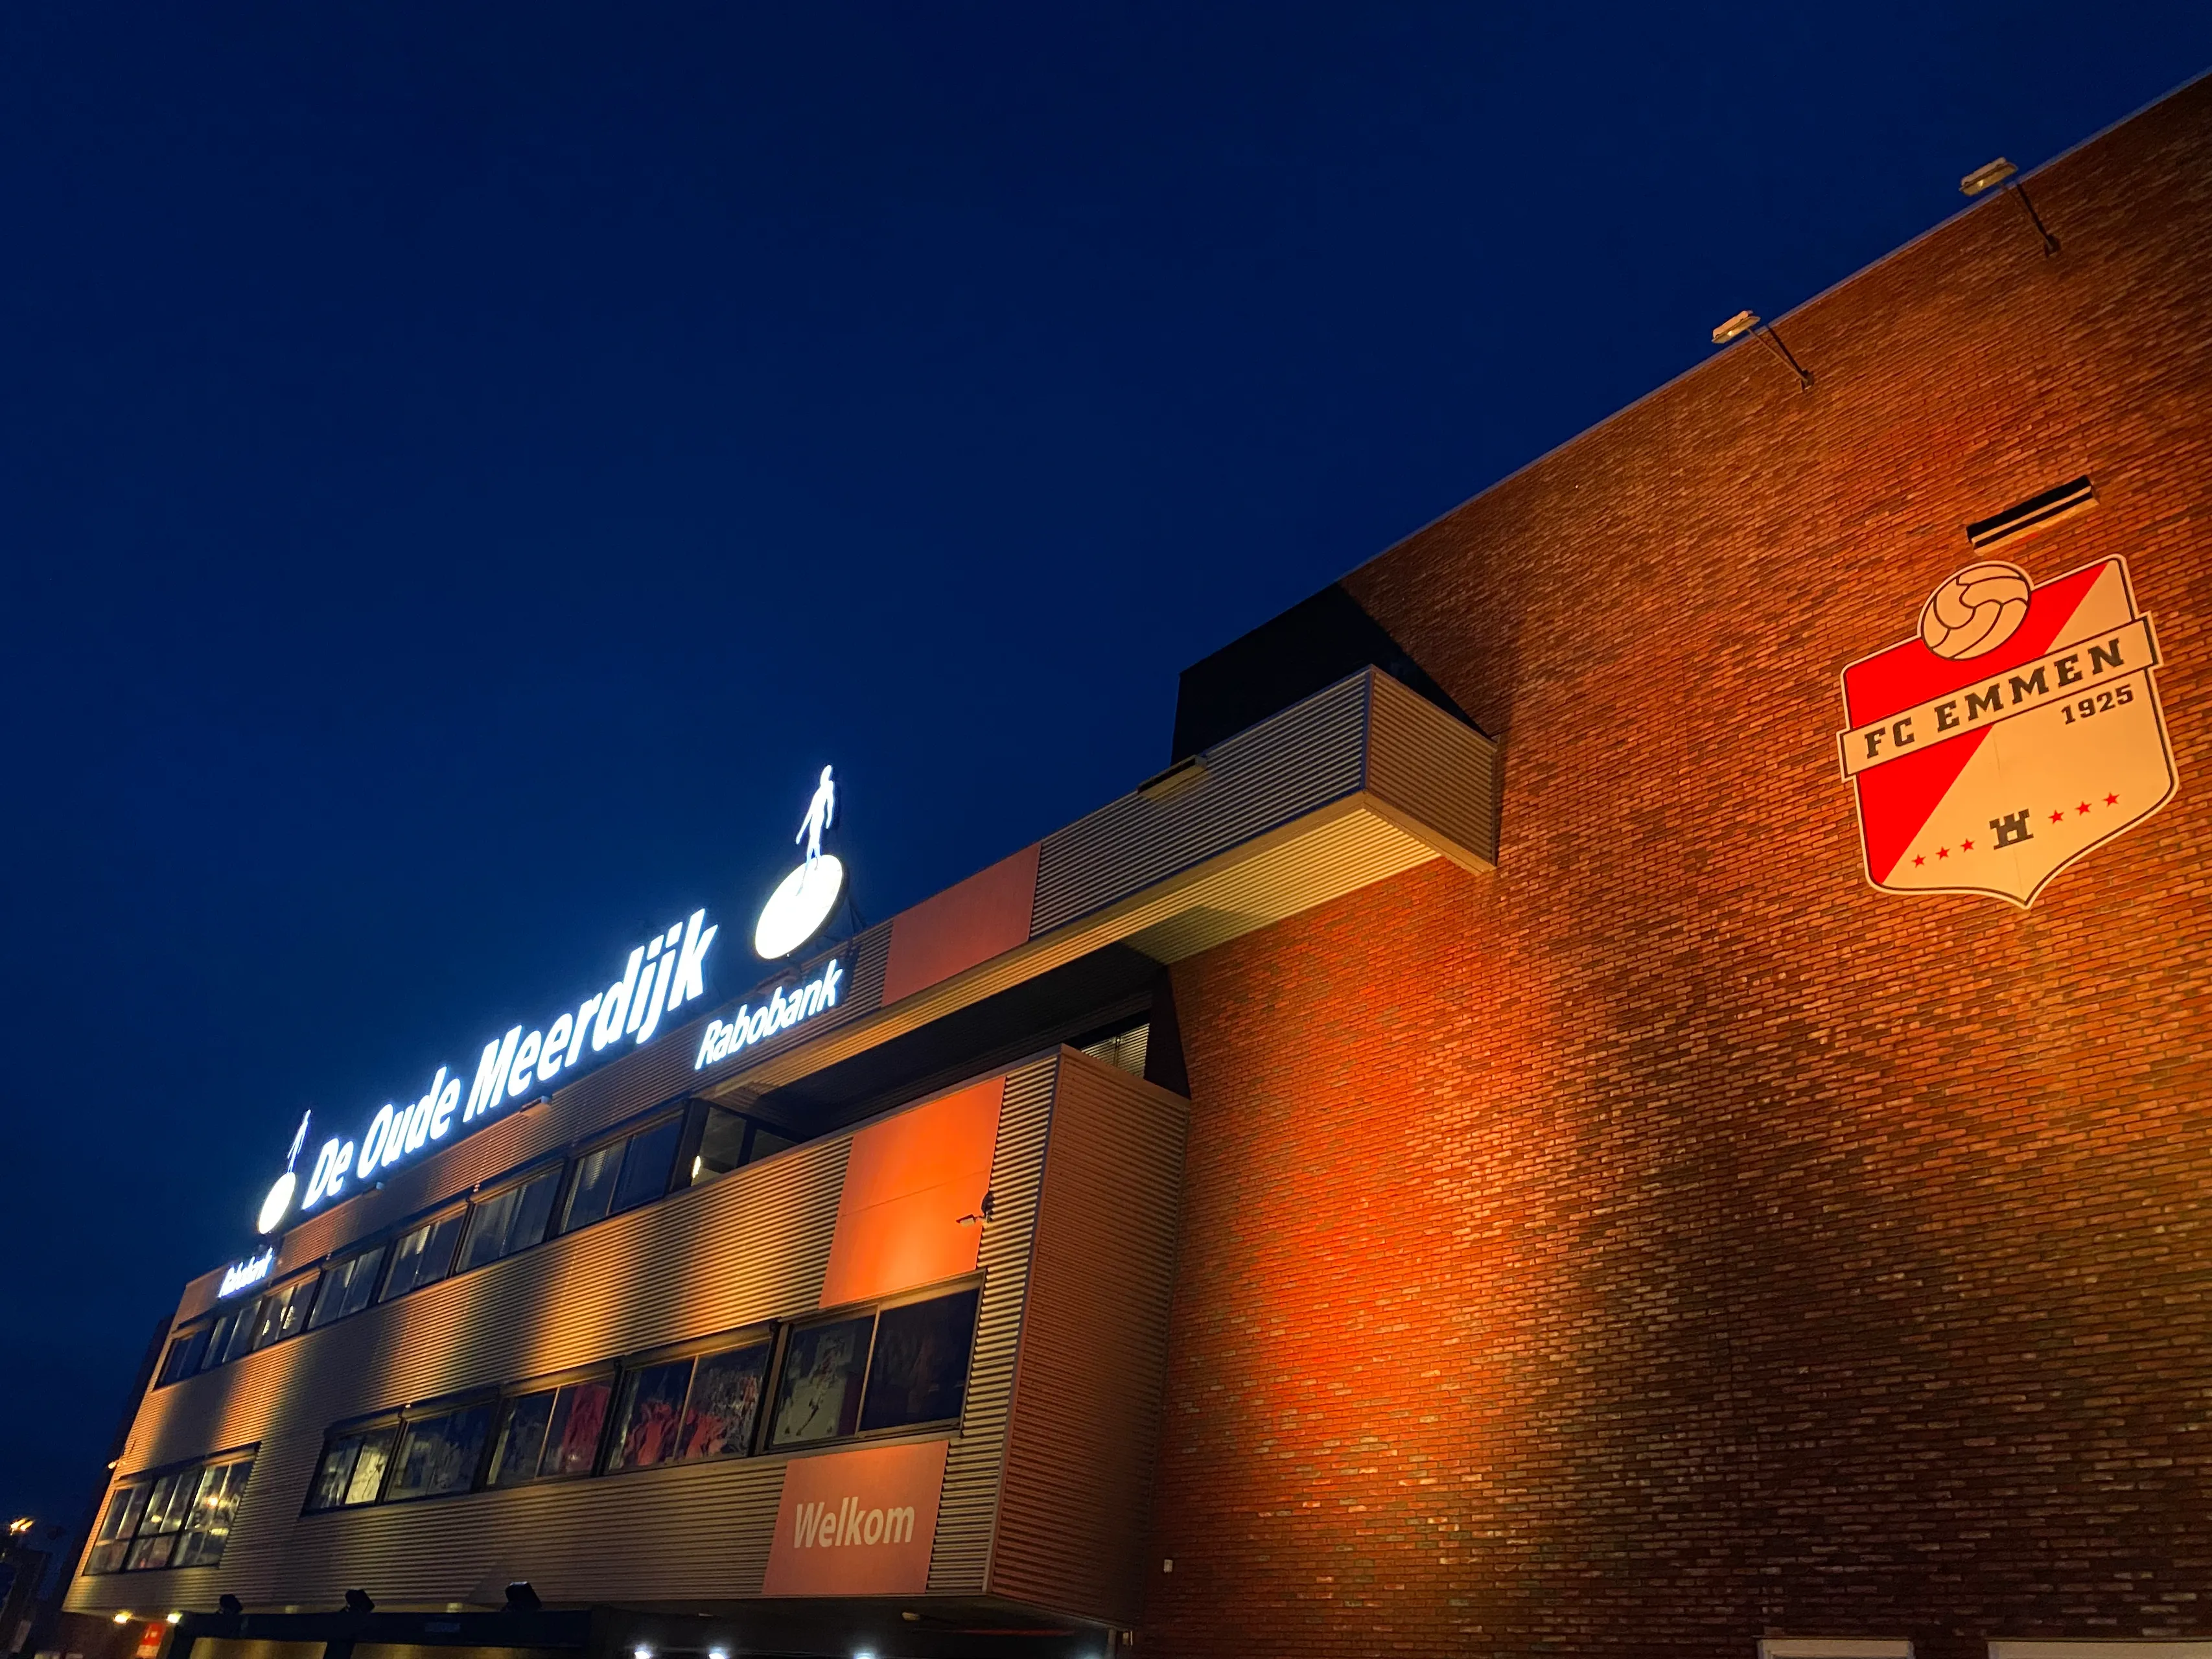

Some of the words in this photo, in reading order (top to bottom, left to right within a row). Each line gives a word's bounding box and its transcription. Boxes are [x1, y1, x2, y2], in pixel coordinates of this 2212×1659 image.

[1865, 717, 1915, 758] FC
[1934, 638, 2125, 733] EMMEN
[2061, 684, 2134, 725] 1925
[301, 1137, 355, 1211] De
[356, 1066, 461, 1179] Oude
[462, 908, 718, 1122] Meerdijk
[695, 958, 843, 1070] Rabobank
[794, 1496, 915, 1548] Welkom
